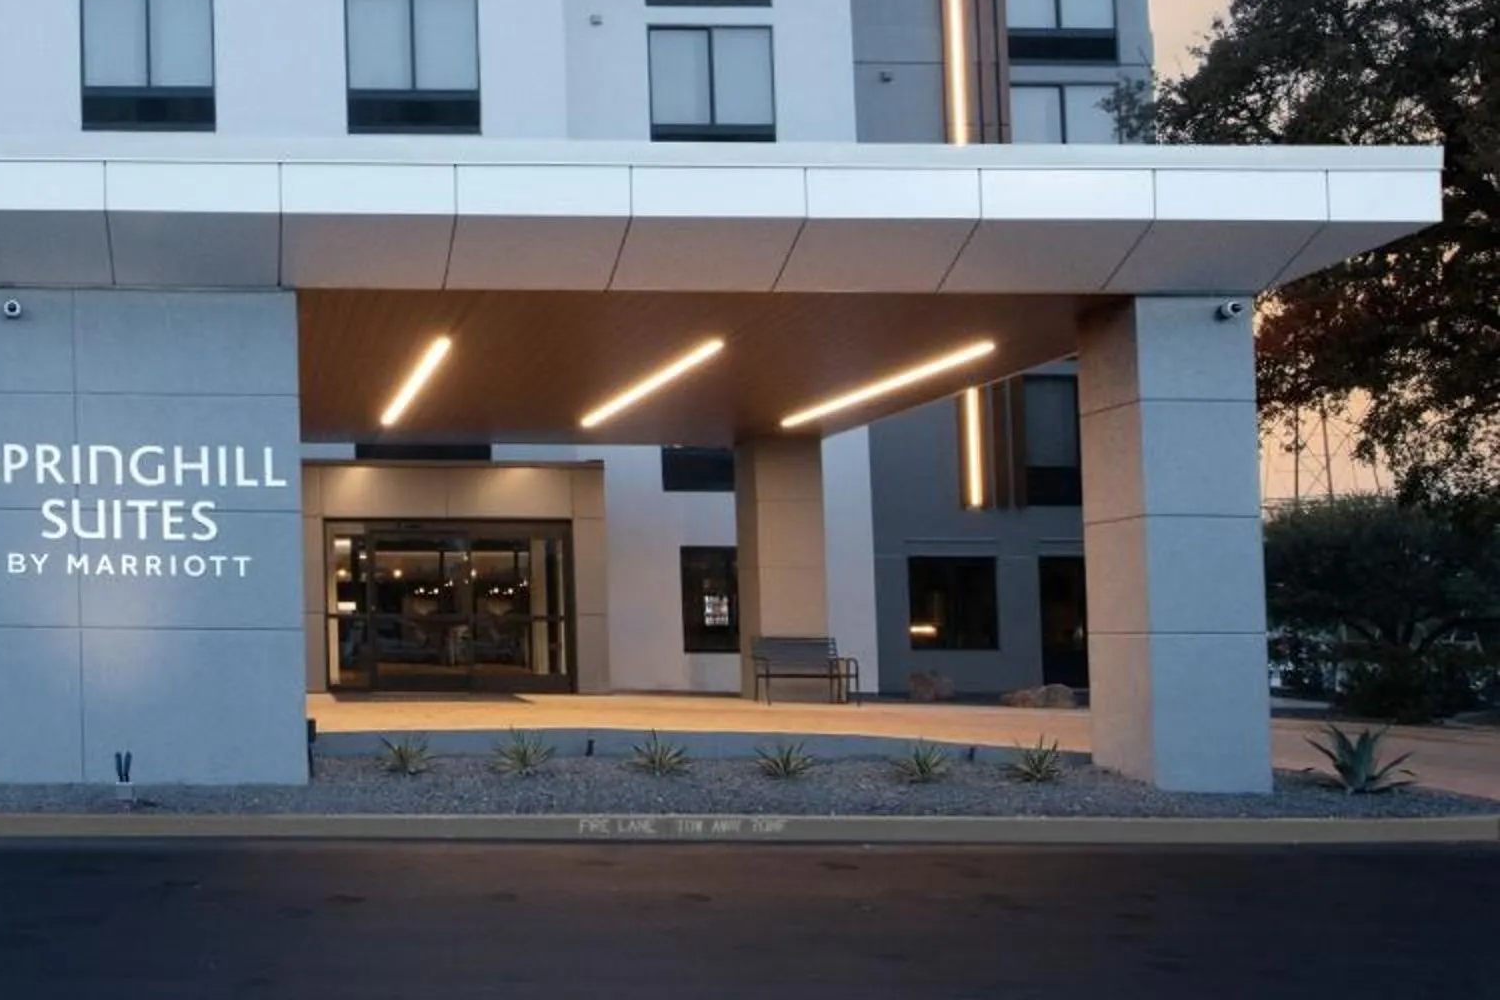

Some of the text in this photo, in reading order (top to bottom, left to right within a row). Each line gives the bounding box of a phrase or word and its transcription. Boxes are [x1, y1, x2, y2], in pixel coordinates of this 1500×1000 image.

[41, 498, 218, 541] SUITES
[7, 553, 252, 577] BY MARRIOTT
